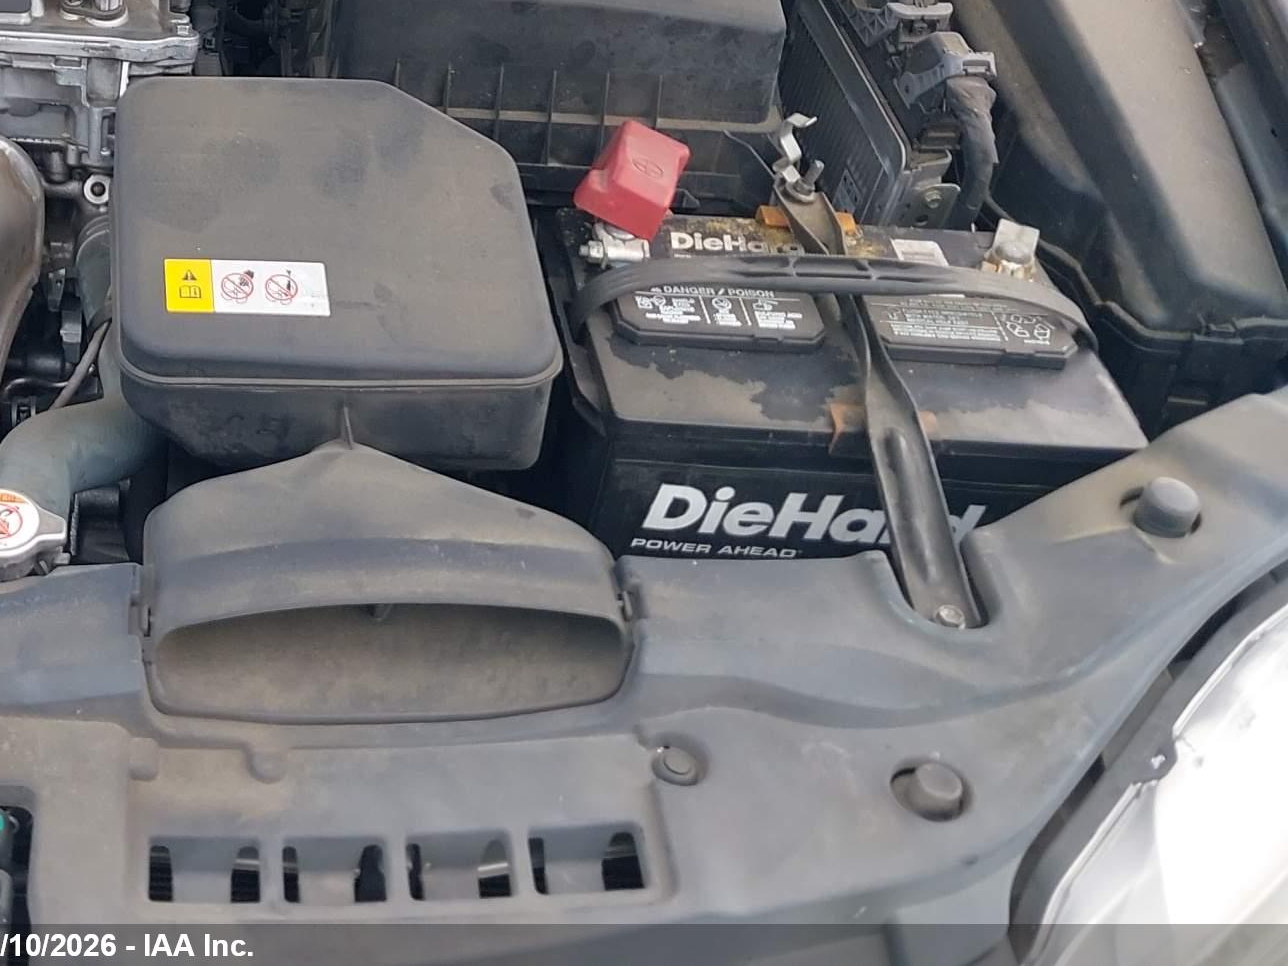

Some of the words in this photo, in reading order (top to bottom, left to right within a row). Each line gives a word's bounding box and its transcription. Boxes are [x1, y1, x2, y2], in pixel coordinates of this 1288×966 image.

[663, 285, 715, 296] DANGER
[727, 287, 776, 298] POISON
[641, 482, 987, 546] DieHad
[630, 537, 712, 555] POWER
[718, 544, 798, 558] AHEAD
